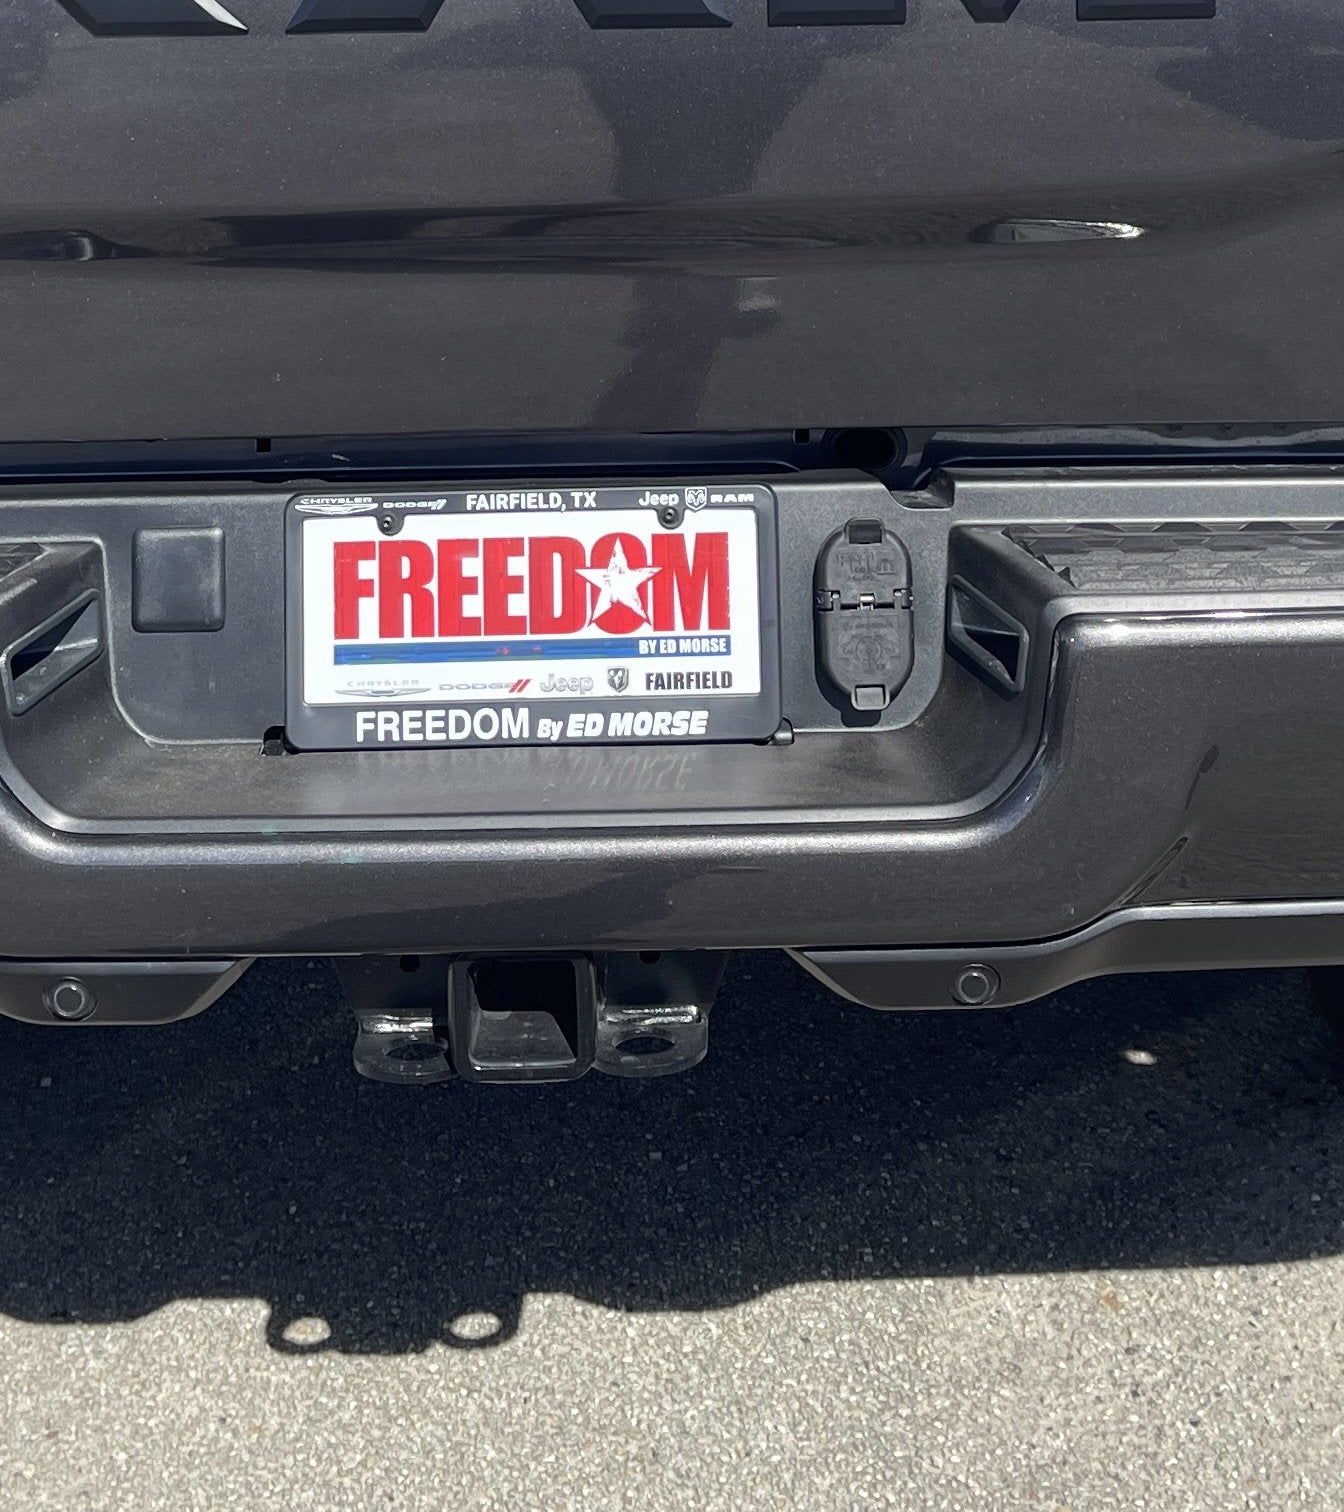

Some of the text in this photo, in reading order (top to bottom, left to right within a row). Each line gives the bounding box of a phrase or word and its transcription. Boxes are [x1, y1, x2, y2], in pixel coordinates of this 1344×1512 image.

[299, 496, 373, 506] CHRYSLER
[465, 491, 597, 512] FAIRFIELD, TX
[638, 491, 754, 507] Jeep RAM
[333, 532, 731, 640] FREEDOM
[638, 637, 727, 655] BY ED MORSE
[346, 679, 420, 687] CHRYSLER
[540, 670, 733, 694] Jeep FAIRFIELD
[356, 707, 709, 743] FREEDOM By ED MORSE
